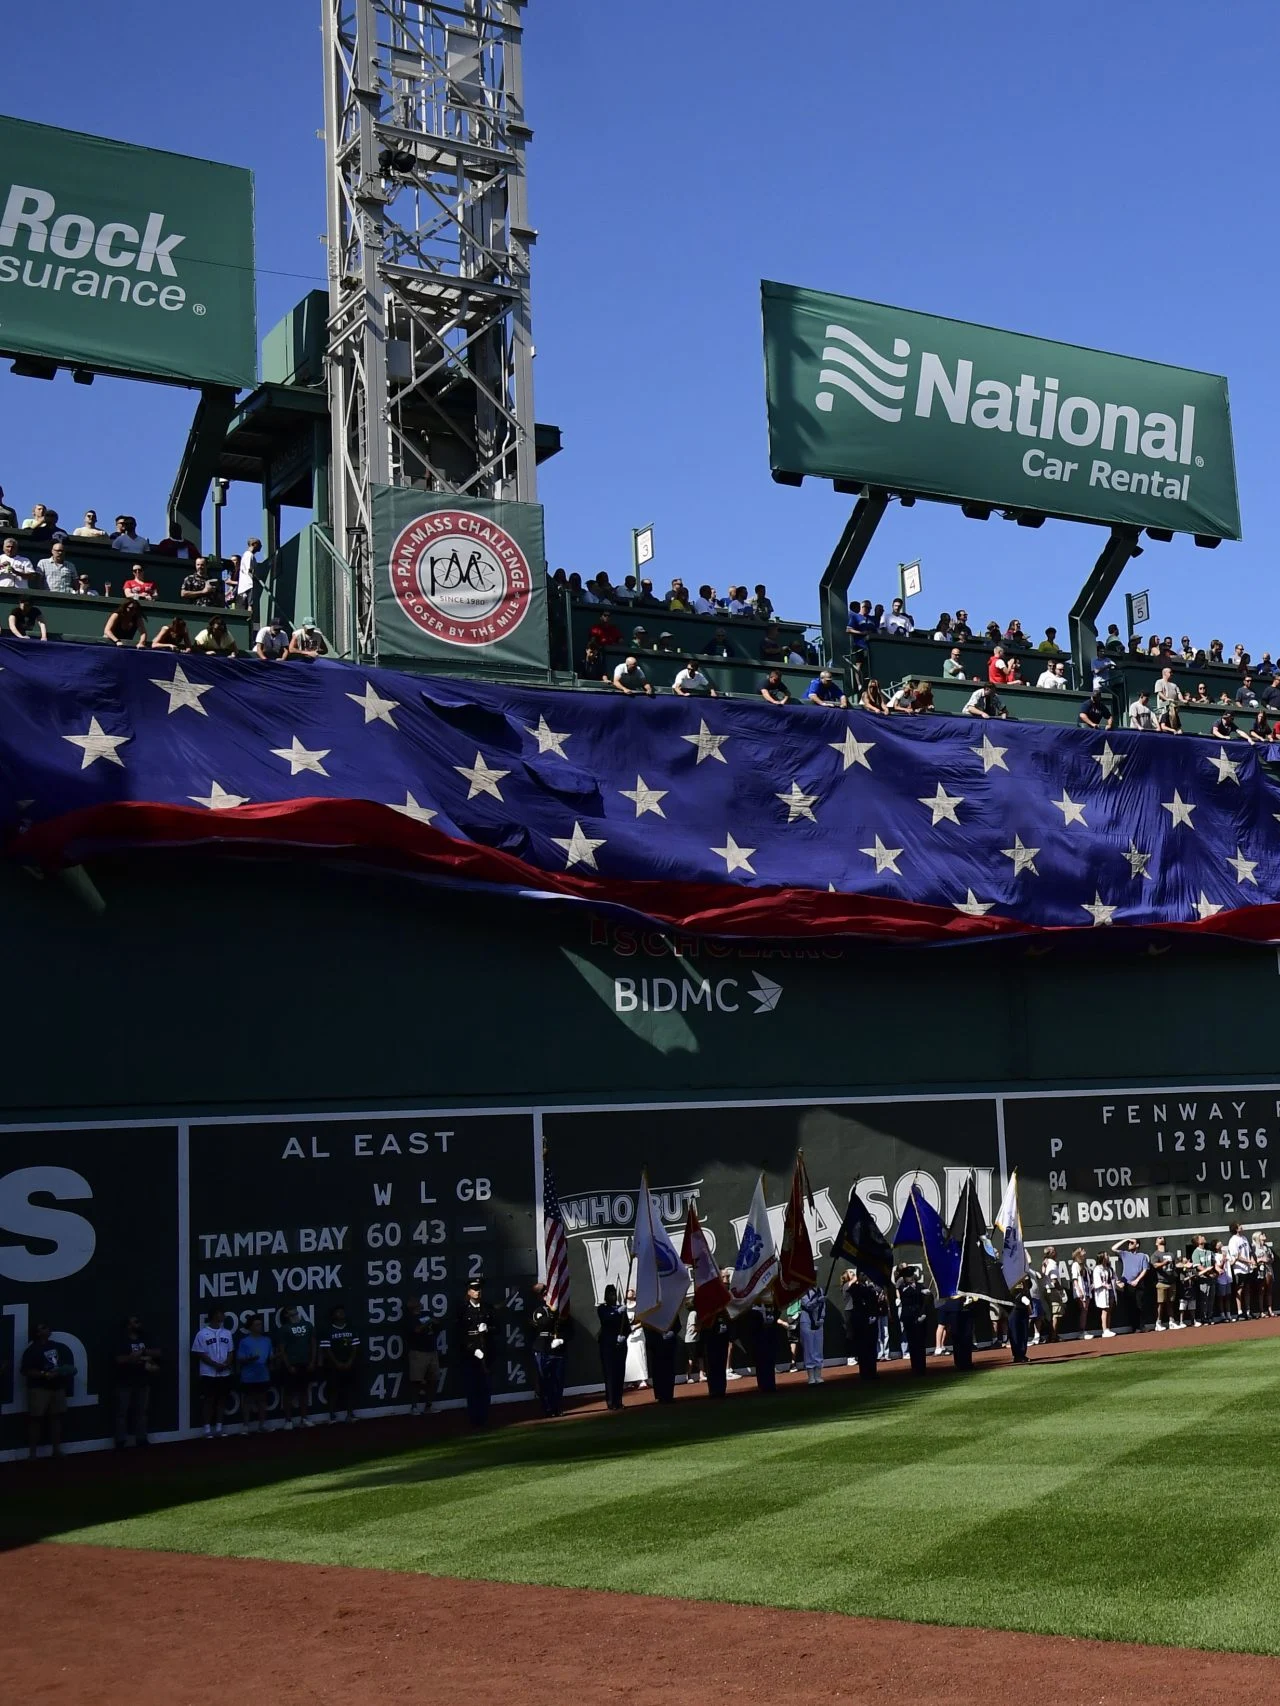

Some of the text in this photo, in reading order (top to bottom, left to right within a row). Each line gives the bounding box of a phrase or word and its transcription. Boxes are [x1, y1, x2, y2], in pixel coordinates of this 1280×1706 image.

[0, 183, 187, 278] Rock
[1022, 448, 1190, 502] Car Rental
[398, 516, 525, 589] PAN-MASS CHALLENGE
[404, 591, 520, 638] CLOSER BY THE MILE
[440, 595, 486, 606] SINCE 1980
[614, 977, 740, 1012] BIDMC
[1102, 1101, 1247, 1125] FENWAY
[281, 1131, 455, 1160] AL EAST
[1051, 1138, 1063, 1158] P
[1157, 1132, 1163, 1152] 1
[1174, 1131, 1186, 1151] 2
[1194, 1130, 1206, 1151] 3
[1218, 1129, 1231, 1149] 4
[1238, 1129, 1249, 1149] 5
[1255, 1128, 1268, 1149] 6
[1050, 1170, 1067, 1191] 84
[1094, 1167, 1132, 1188] TOR
[1196, 1159, 1268, 1182] JULY
[373, 1177, 492, 1206] W L GB
[559, 1194, 635, 1231] WHO
[1051, 1204, 1069, 1225] 54
[1078, 1198, 1150, 1223] BOSTON
[199, 1218, 447, 1259] TAMPA BAY 60 43
[199, 1253, 484, 1299] NEW YORK 58 45 2
[368, 1296, 403, 1325] 53
[368, 1335, 403, 1362] 50
[369, 1371, 404, 1400] 47
